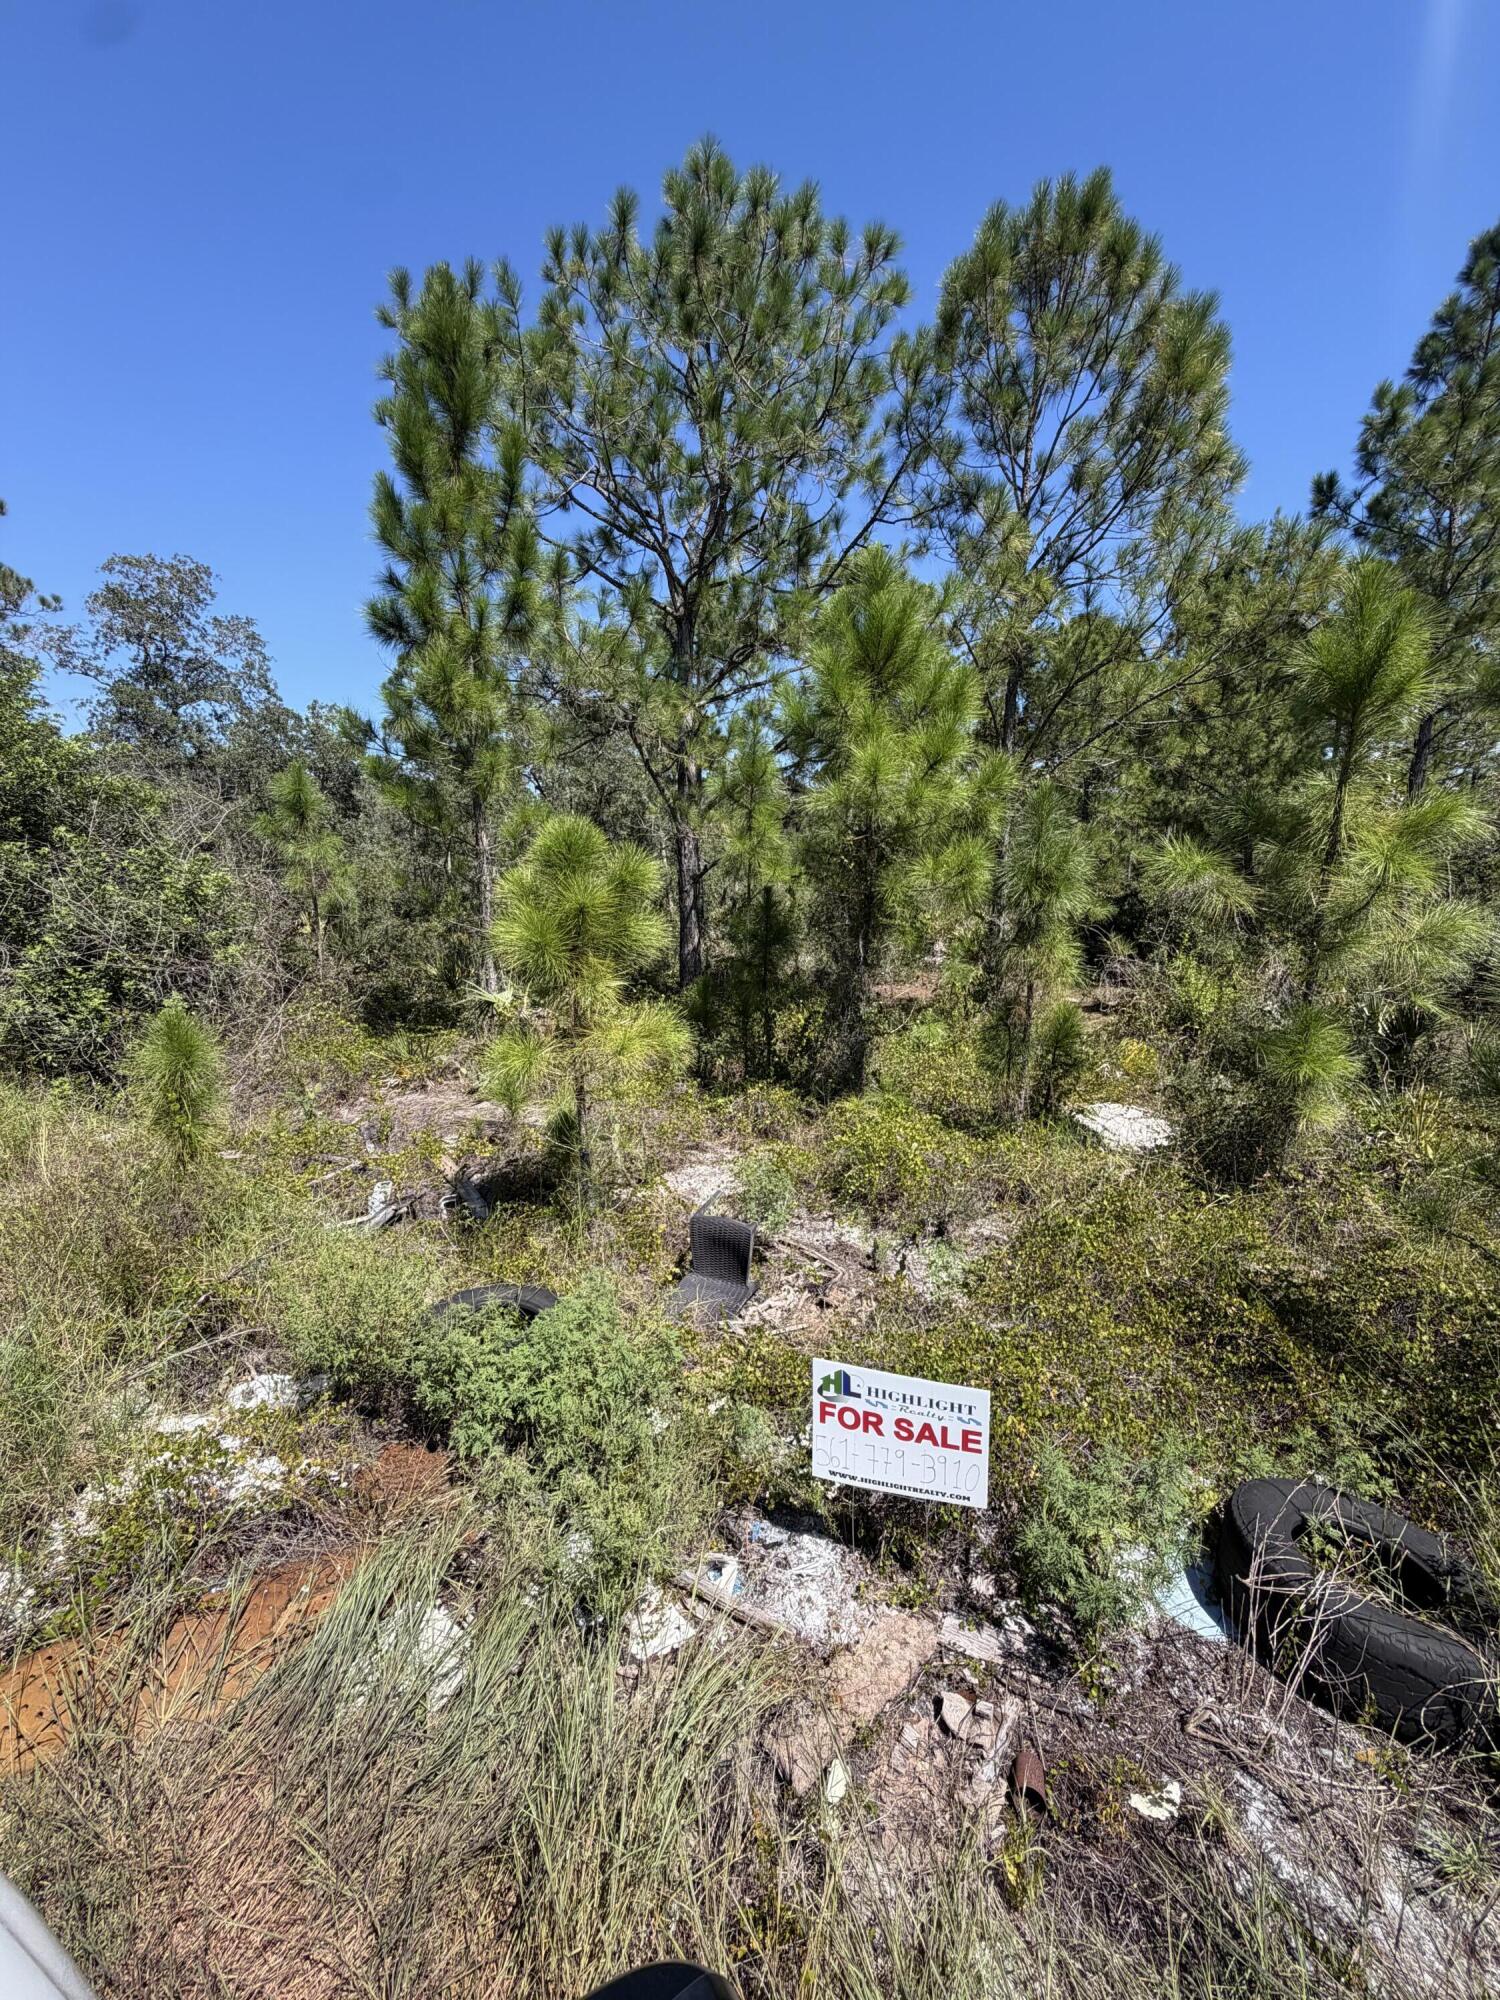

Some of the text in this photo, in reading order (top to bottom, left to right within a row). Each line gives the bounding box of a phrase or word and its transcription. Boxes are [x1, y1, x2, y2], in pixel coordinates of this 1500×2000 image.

[867, 1386, 977, 1415] HIGHLIGHT
[899, 1404, 944, 1422] Realty
[819, 1401, 983, 1454] FOR SALE
